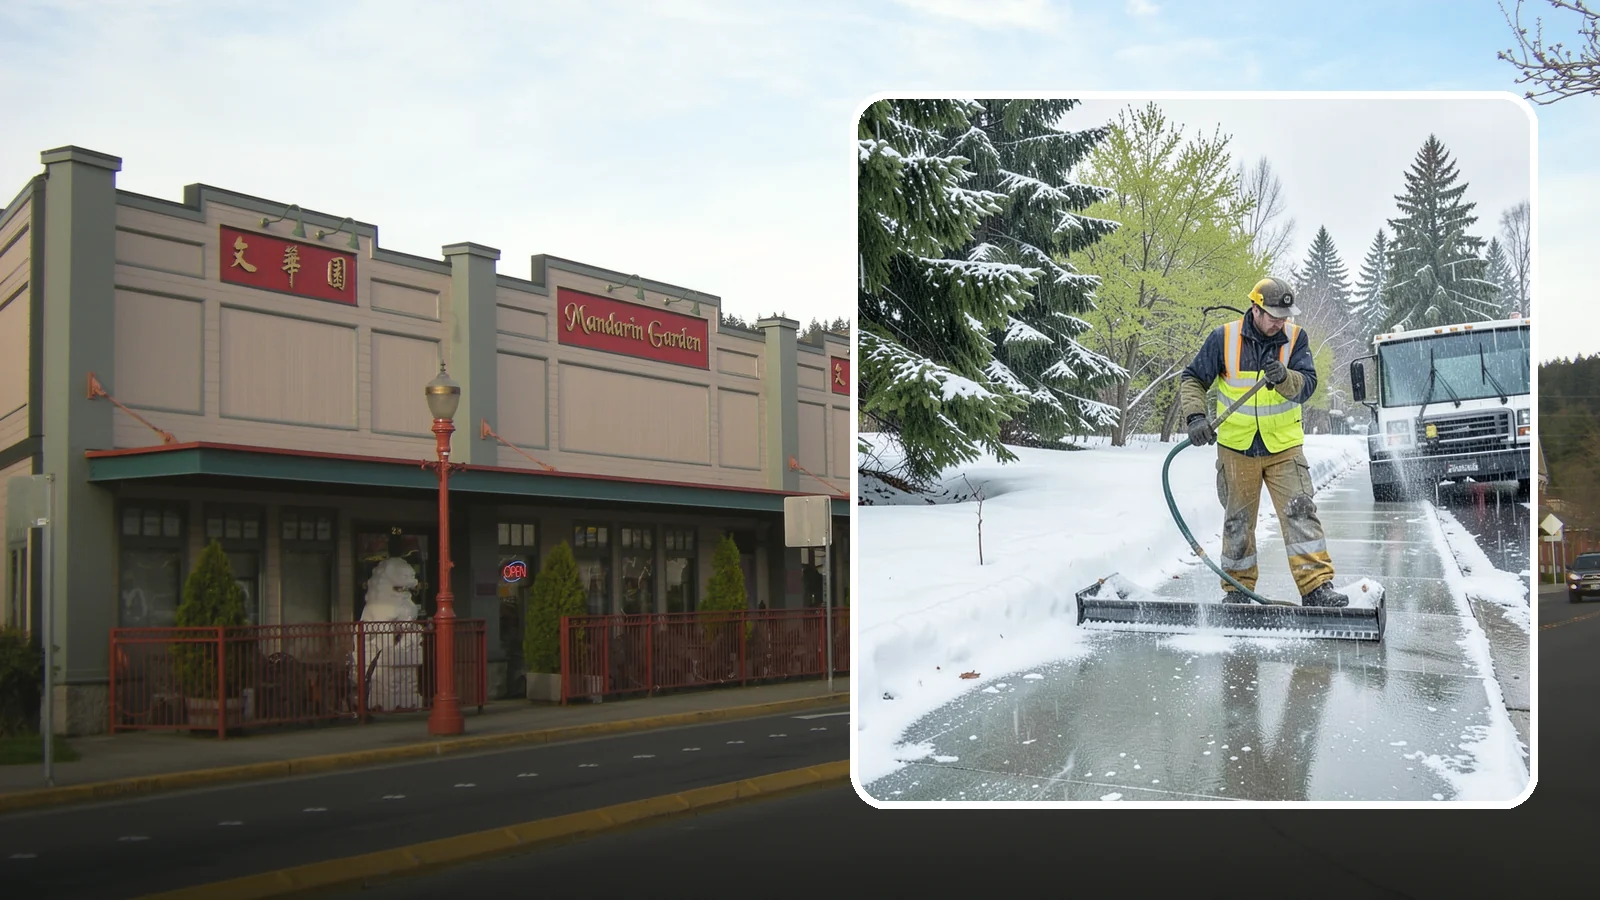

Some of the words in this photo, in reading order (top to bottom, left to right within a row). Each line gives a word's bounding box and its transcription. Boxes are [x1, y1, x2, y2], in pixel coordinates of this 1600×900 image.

[230, 235, 347, 291] 文華園
[564, 302, 644, 341] Mandarin
[647, 320, 702, 352] Garden
[834, 363, 847, 386] 文
[503, 565, 527, 578] OPEN
